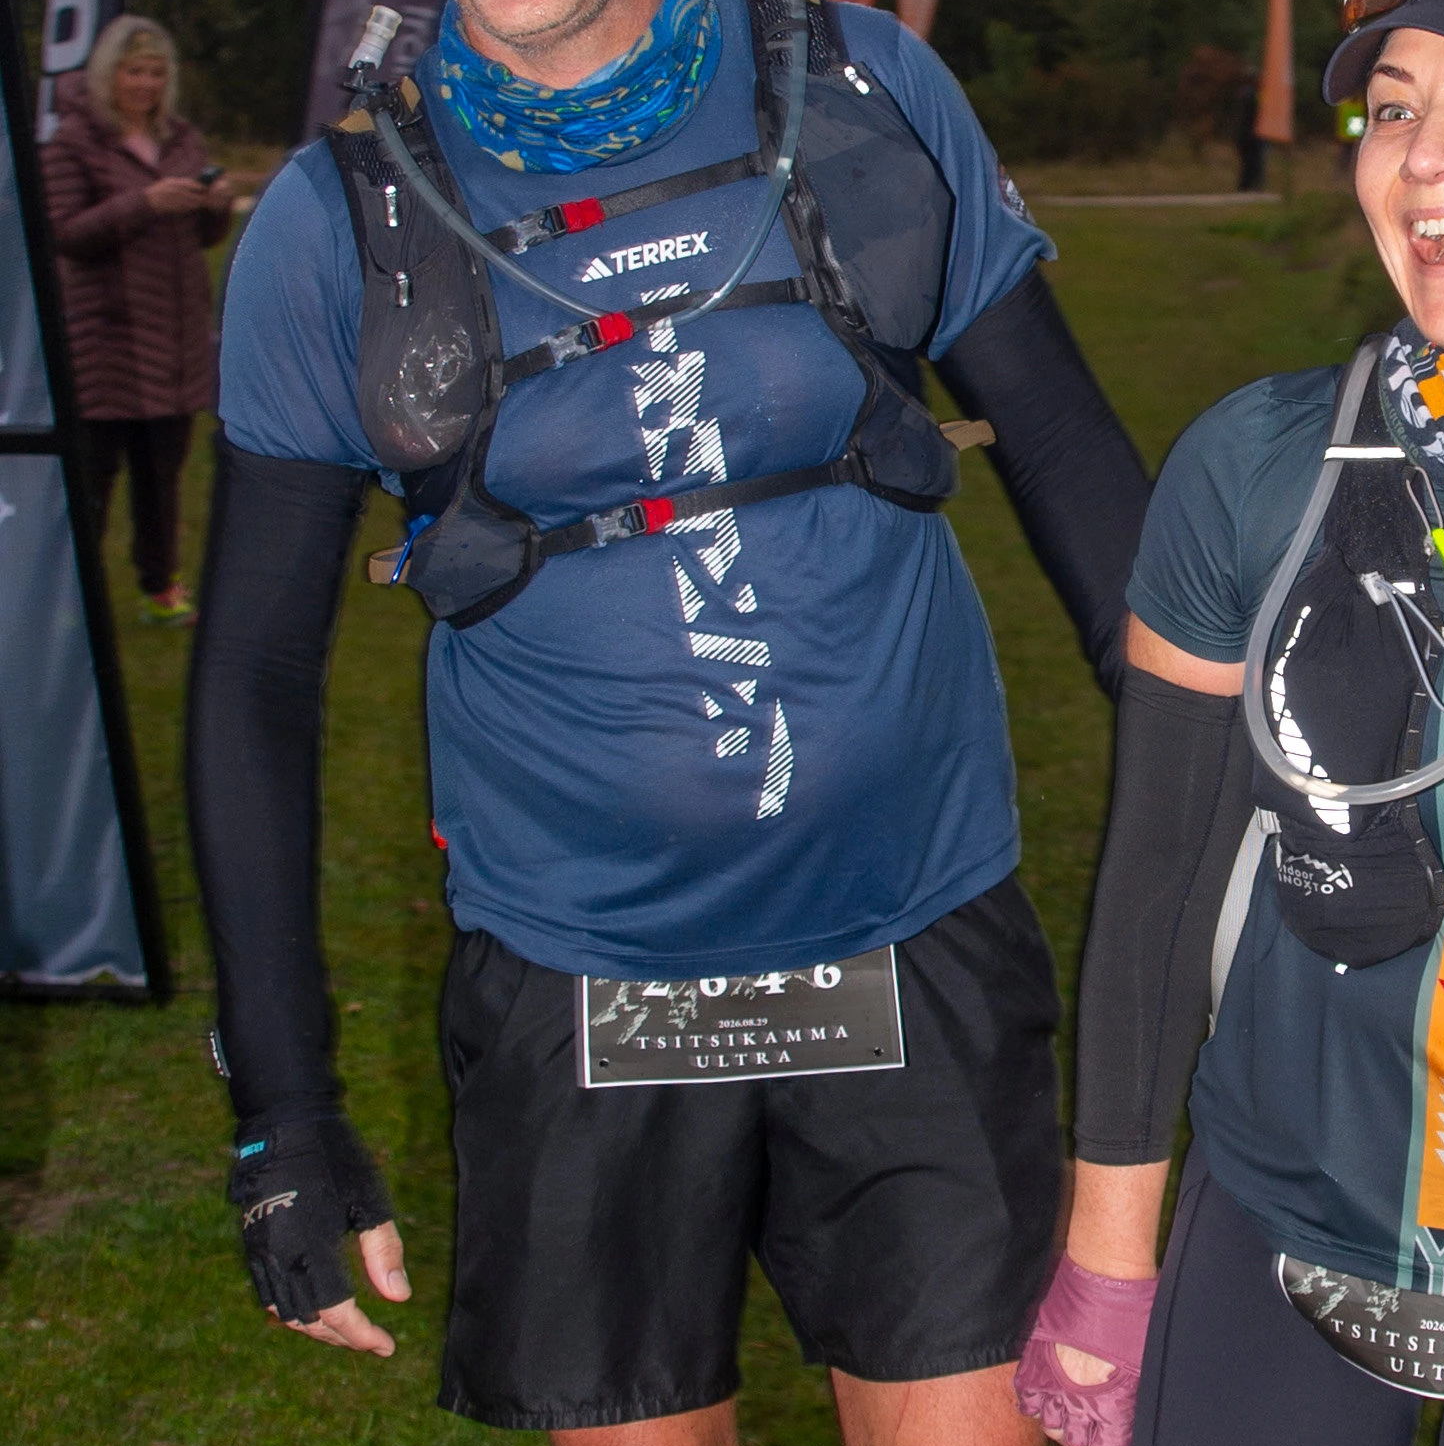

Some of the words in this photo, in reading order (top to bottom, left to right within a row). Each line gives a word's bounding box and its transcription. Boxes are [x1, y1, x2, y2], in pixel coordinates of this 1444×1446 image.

[610, 230, 709, 274] TERREX
[718, 1017, 769, 1029] 2026.08.29
[636, 1025, 849, 1050] TSITSIKAMMA
[695, 1050, 792, 1069] ULTRA
